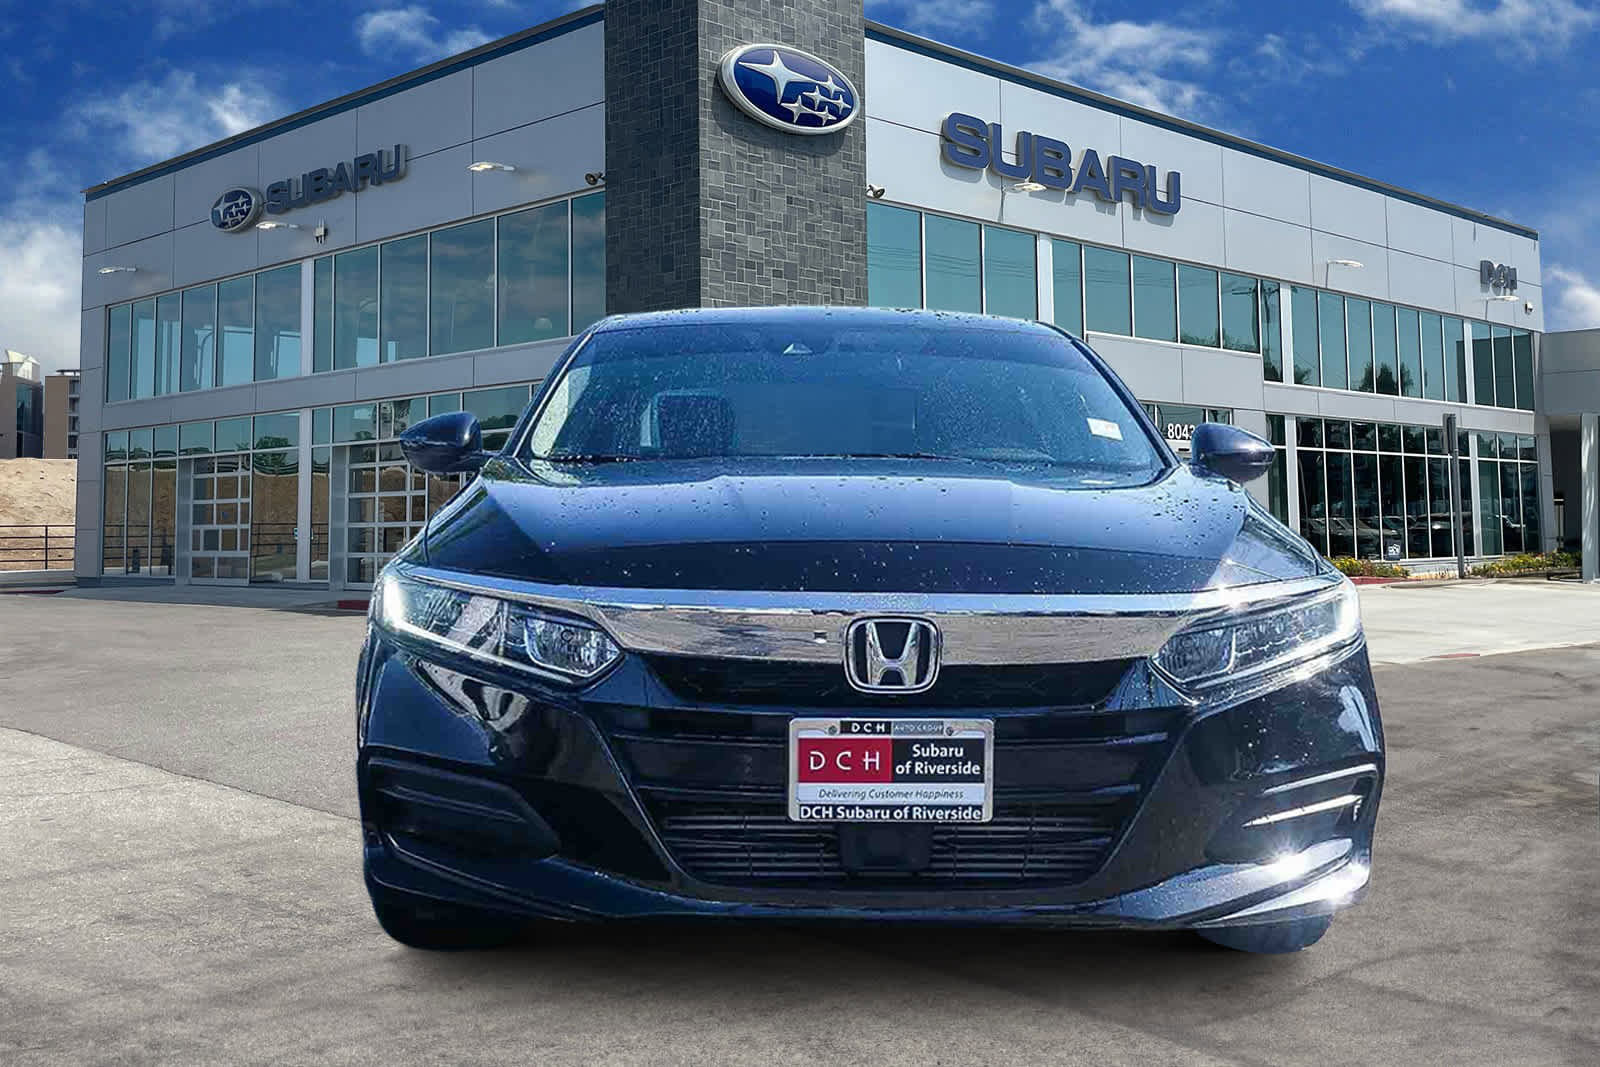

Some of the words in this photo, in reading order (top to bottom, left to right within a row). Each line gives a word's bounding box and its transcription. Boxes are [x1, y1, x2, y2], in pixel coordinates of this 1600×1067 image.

[941, 112, 1181, 215] SUBARU
[266, 144, 407, 214] SUBARU
[851, 723, 885, 732] DCH
[912, 743, 964, 757] Subaru
[809, 751, 880, 770] DCH
[895, 761, 912, 774] of
[914, 761, 981, 774] Riverside
[818, 789, 866, 800] Delivering
[868, 789, 913, 799] Customer
[915, 789, 964, 800] Happiness
[800, 806, 833, 819] DCH
[836, 806, 890, 819] Subaru
[893, 806, 910, 819] of
[912, 806, 982, 819] Riverside
